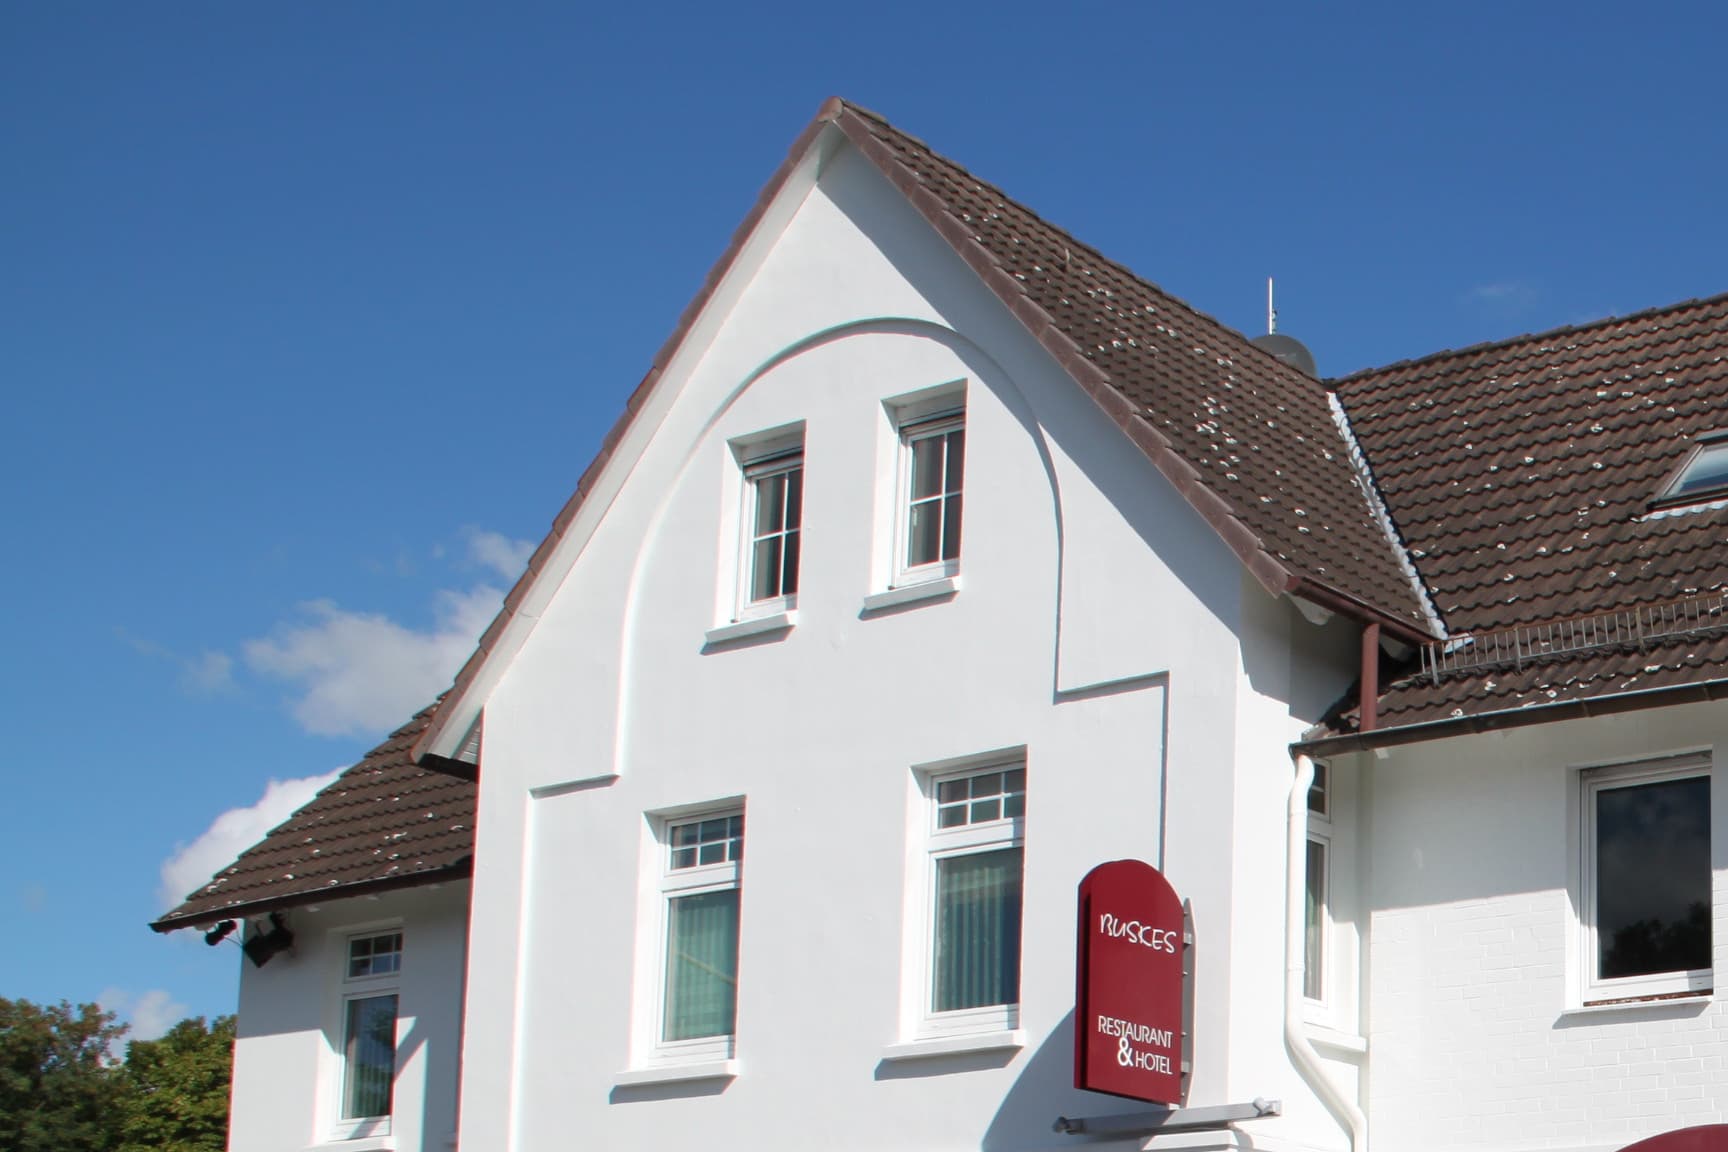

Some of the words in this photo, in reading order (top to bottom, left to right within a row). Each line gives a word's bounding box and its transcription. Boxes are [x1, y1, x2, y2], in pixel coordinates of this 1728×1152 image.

[1099, 913, 1177, 954] BUSKES
[1098, 1015, 1173, 1049] RESTAURANT
[1117, 1036, 1134, 1067] &
[1135, 1052, 1173, 1075] HOTEL
